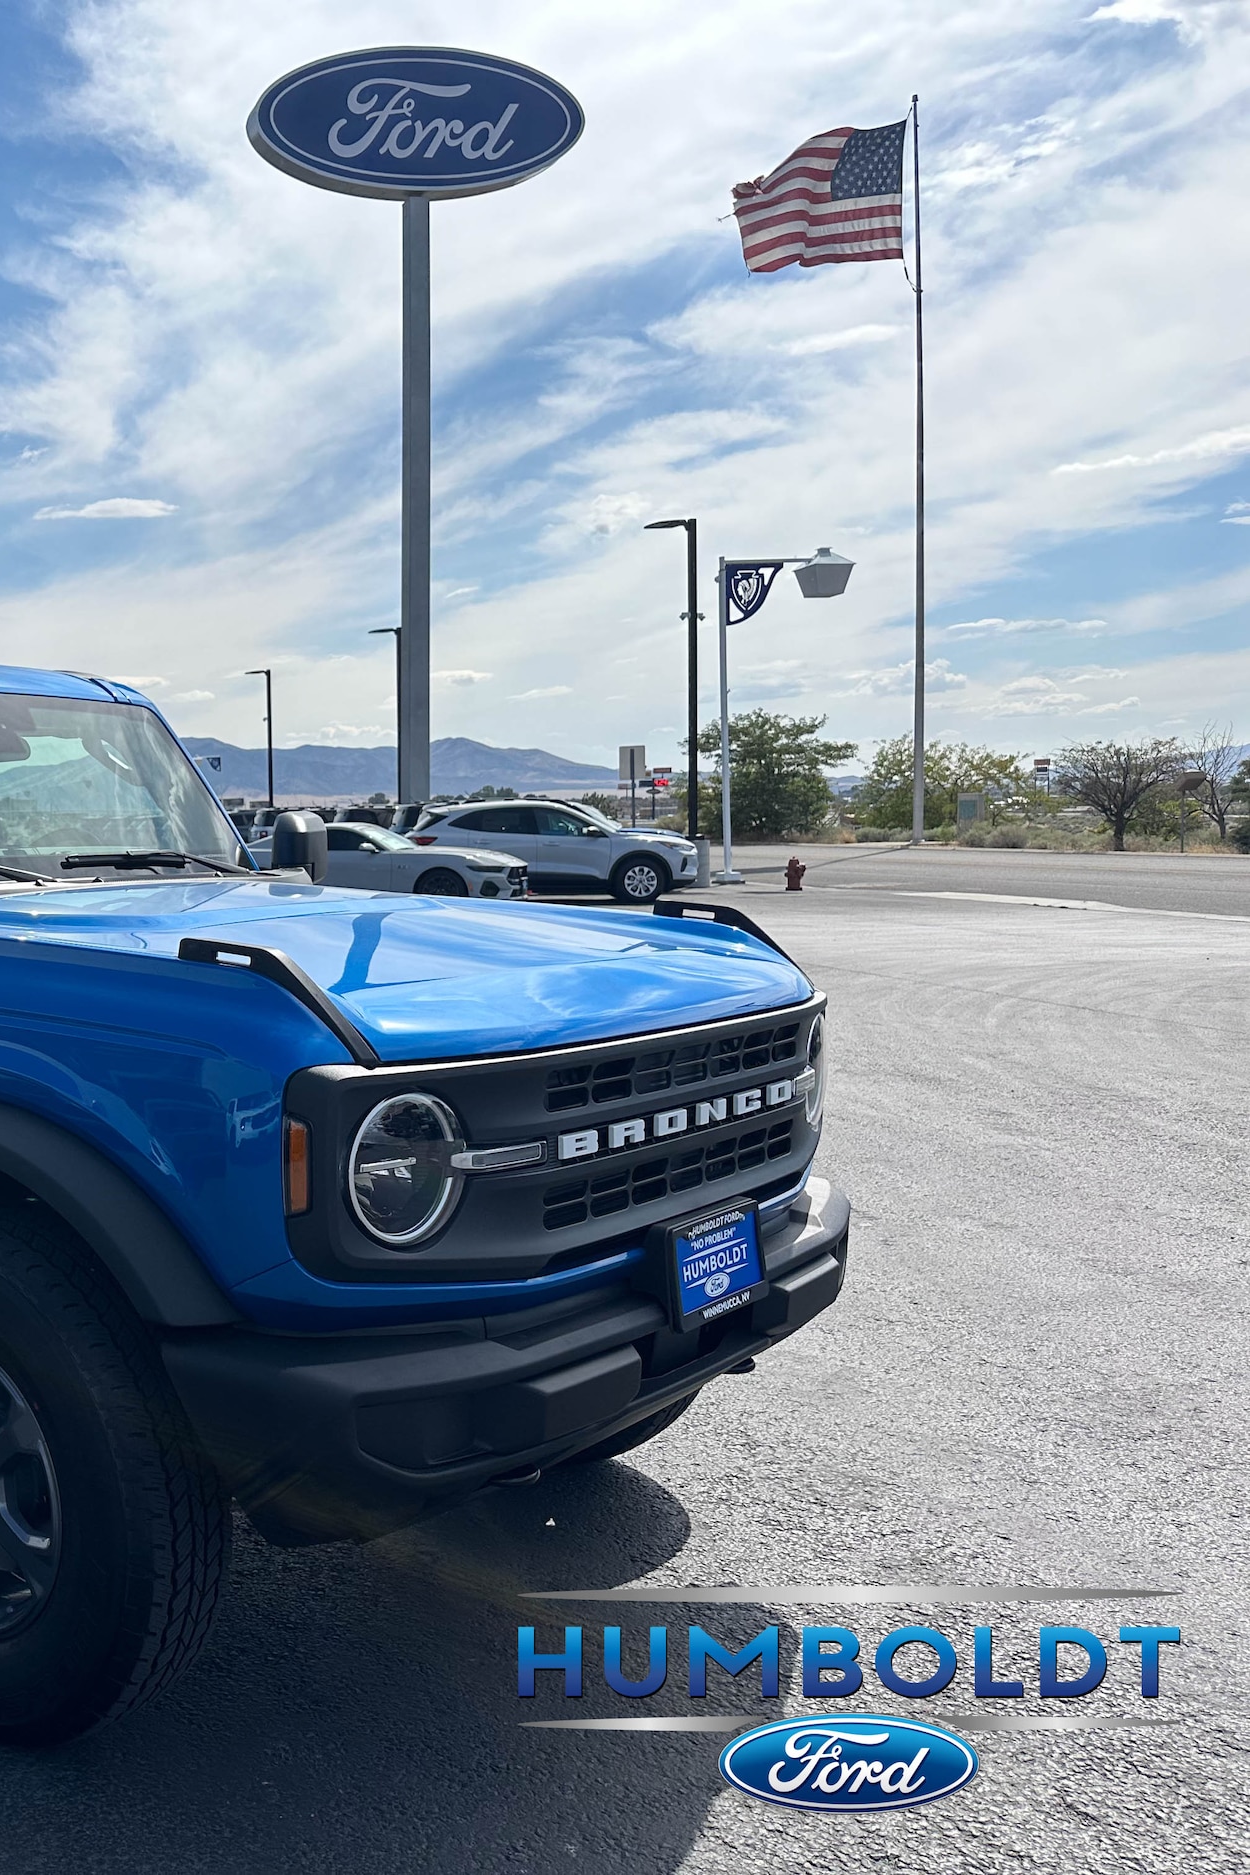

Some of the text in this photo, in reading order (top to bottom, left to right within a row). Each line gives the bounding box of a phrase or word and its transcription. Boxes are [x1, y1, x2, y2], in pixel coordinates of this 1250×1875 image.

[328, 78, 519, 160] Ford
[558, 1080, 792, 1160] BRONCO
[692, 1211, 740, 1235] HUMBOLDT FORD
[683, 1244, 747, 1282] HUMBOLDT
